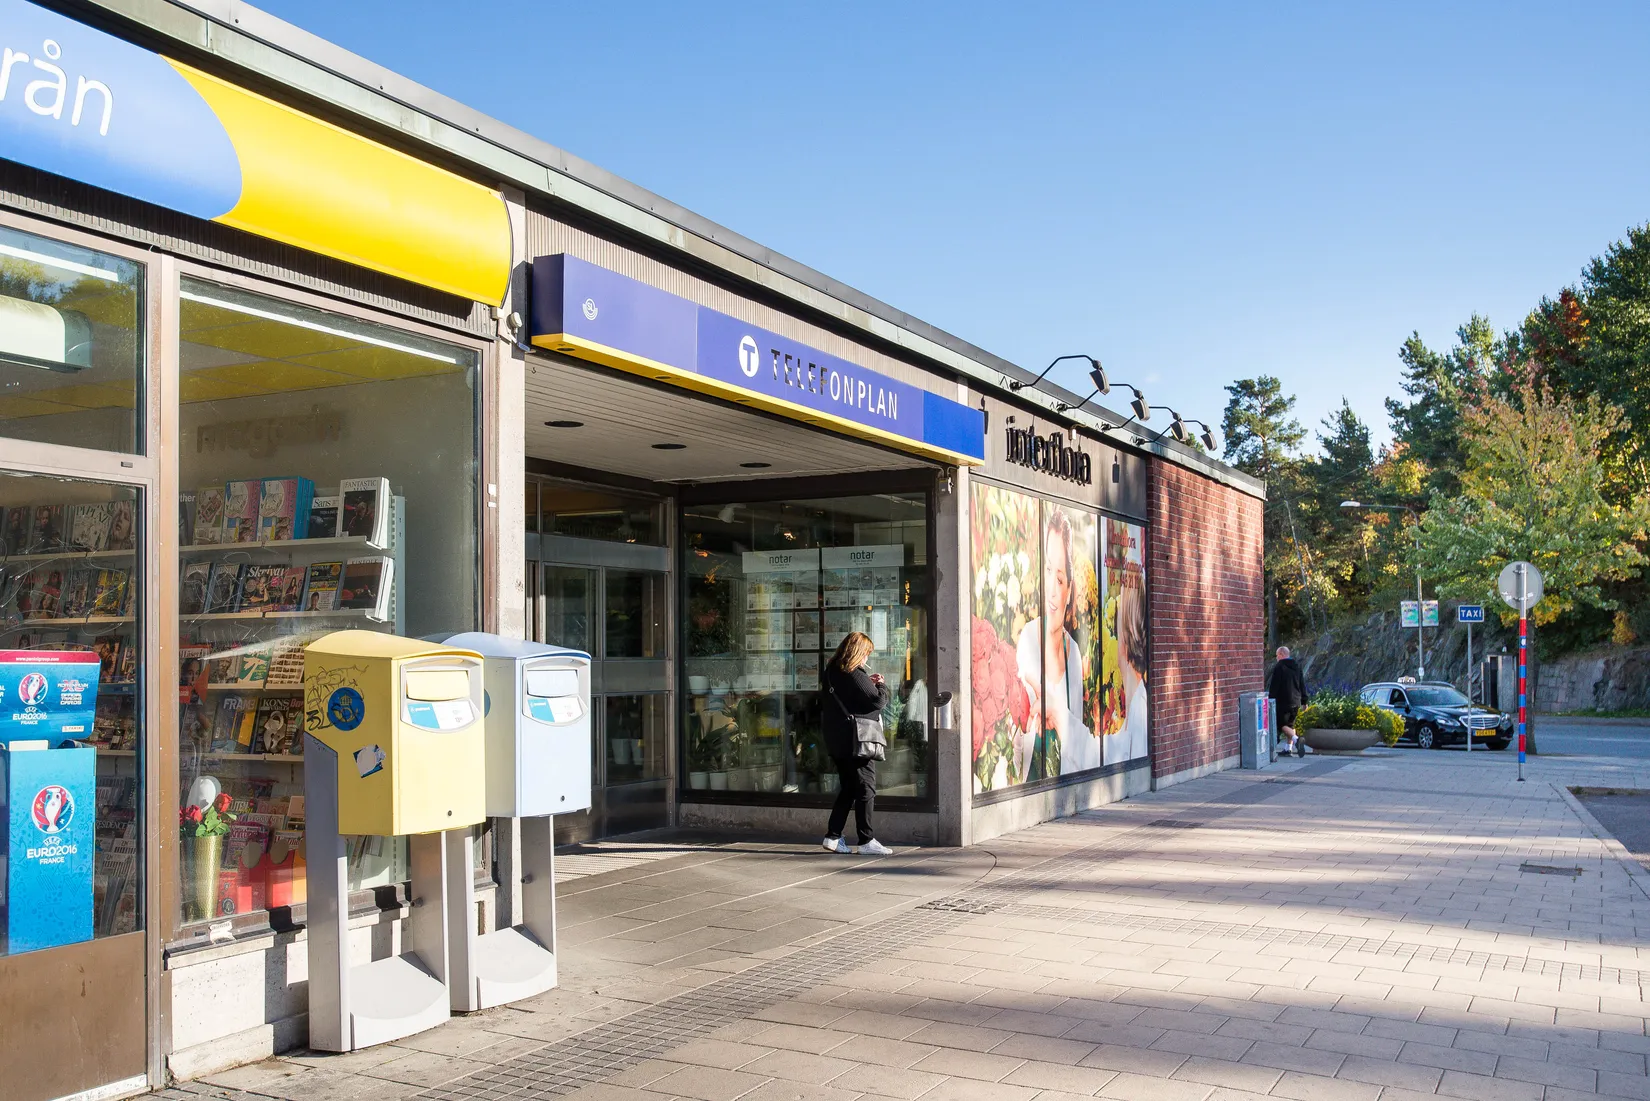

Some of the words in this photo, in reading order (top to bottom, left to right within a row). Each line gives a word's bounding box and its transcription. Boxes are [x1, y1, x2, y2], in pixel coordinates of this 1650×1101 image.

[770, 348, 898, 420] TELEFONPLAN
[345, 480, 376, 488] FANTASTIC
[313, 498, 331, 508] Sans
[769, 554, 793, 564] notar
[850, 550, 875, 560] notar
[1461, 609, 1482, 618] TAXI
[13, 712, 48, 720] EURO2016
[43, 836, 63, 847] UEFA
[26, 844, 78, 859] EURO2016
[39, 857, 65, 865] FRANCE
